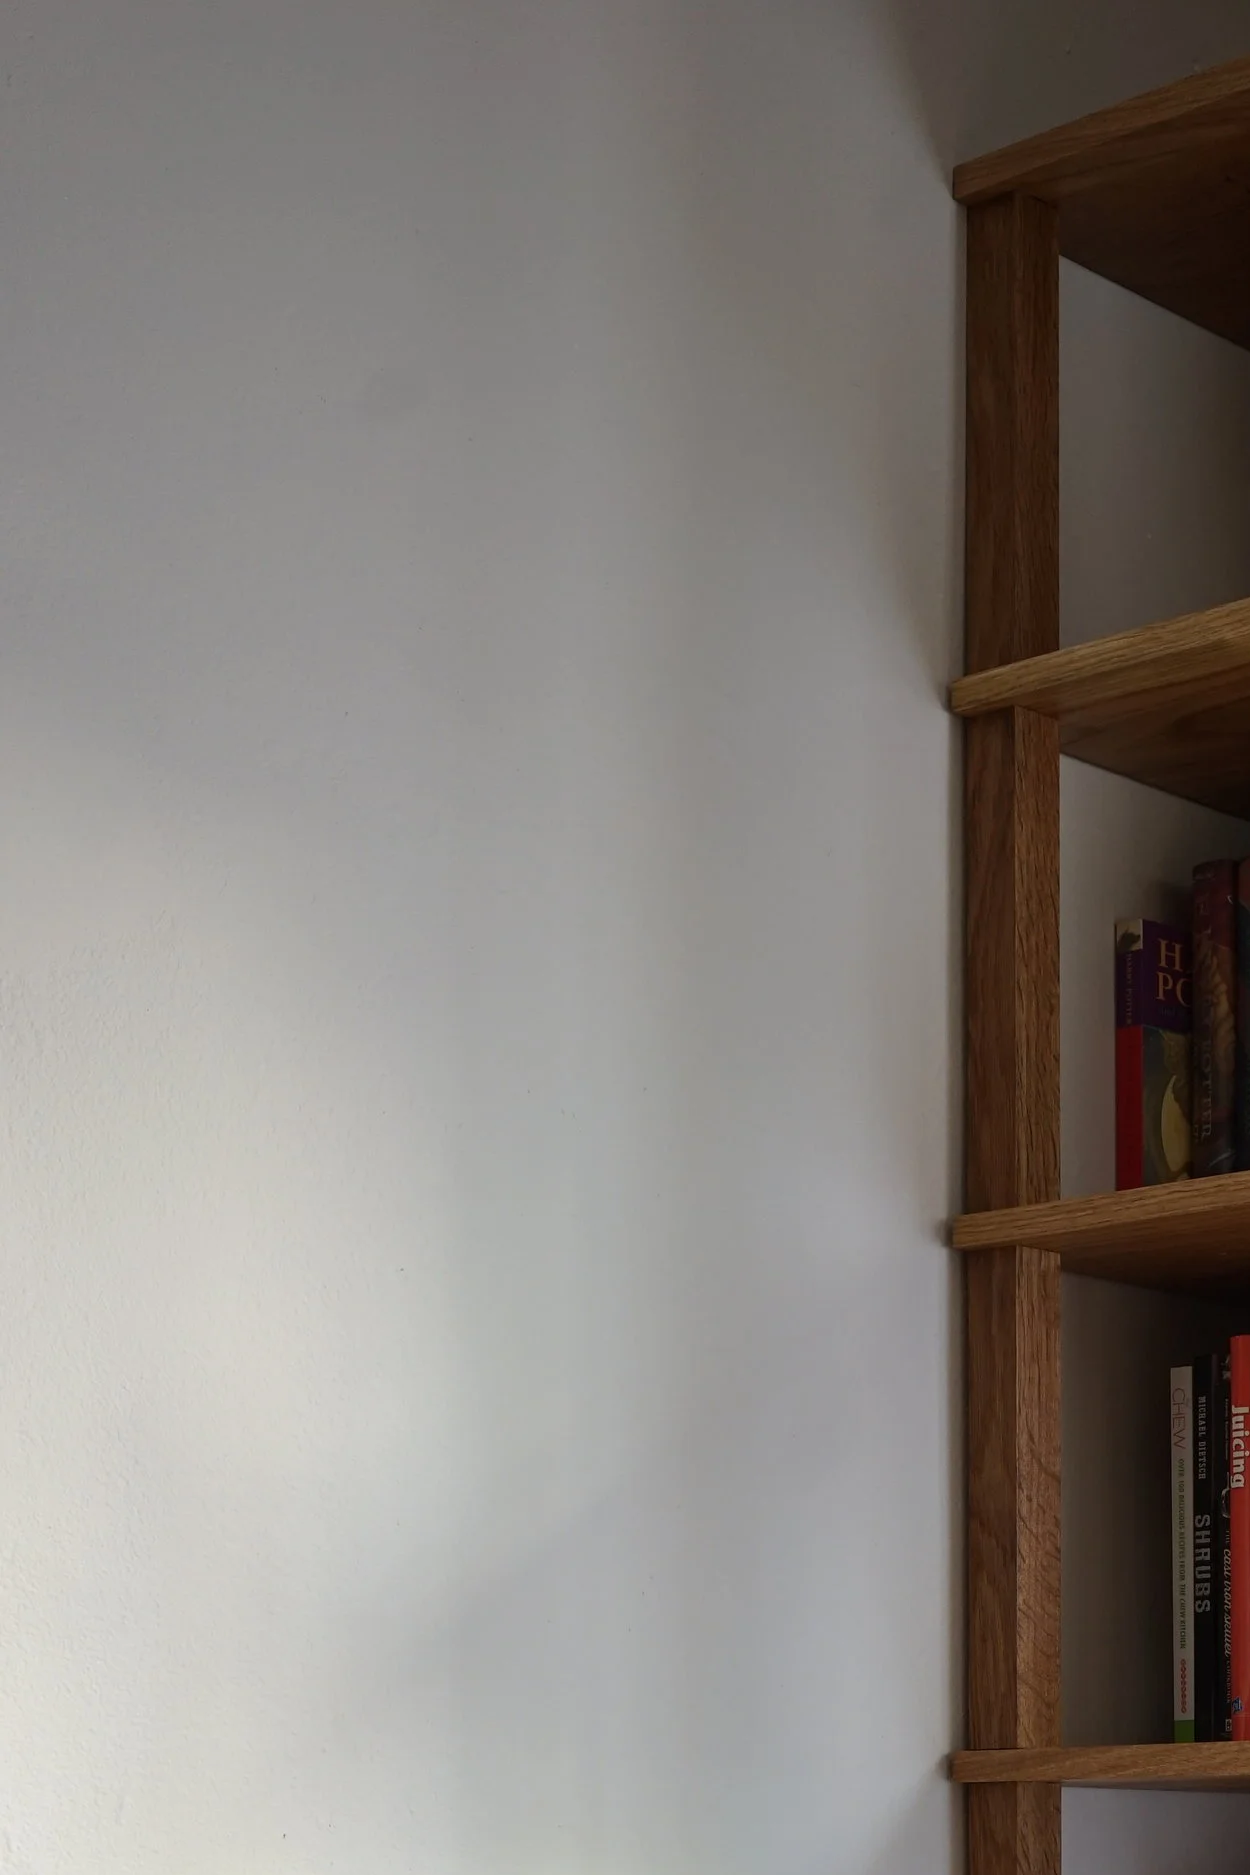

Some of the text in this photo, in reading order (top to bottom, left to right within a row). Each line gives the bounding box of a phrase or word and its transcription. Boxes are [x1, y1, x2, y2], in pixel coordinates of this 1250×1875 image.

[1230, 1403, 1250, 1489] Juicing
[1171, 1386, 1188, 1650] CHEW DELICIOUS KITCHEN
[1193, 1513, 1212, 1614] SHRUBS
